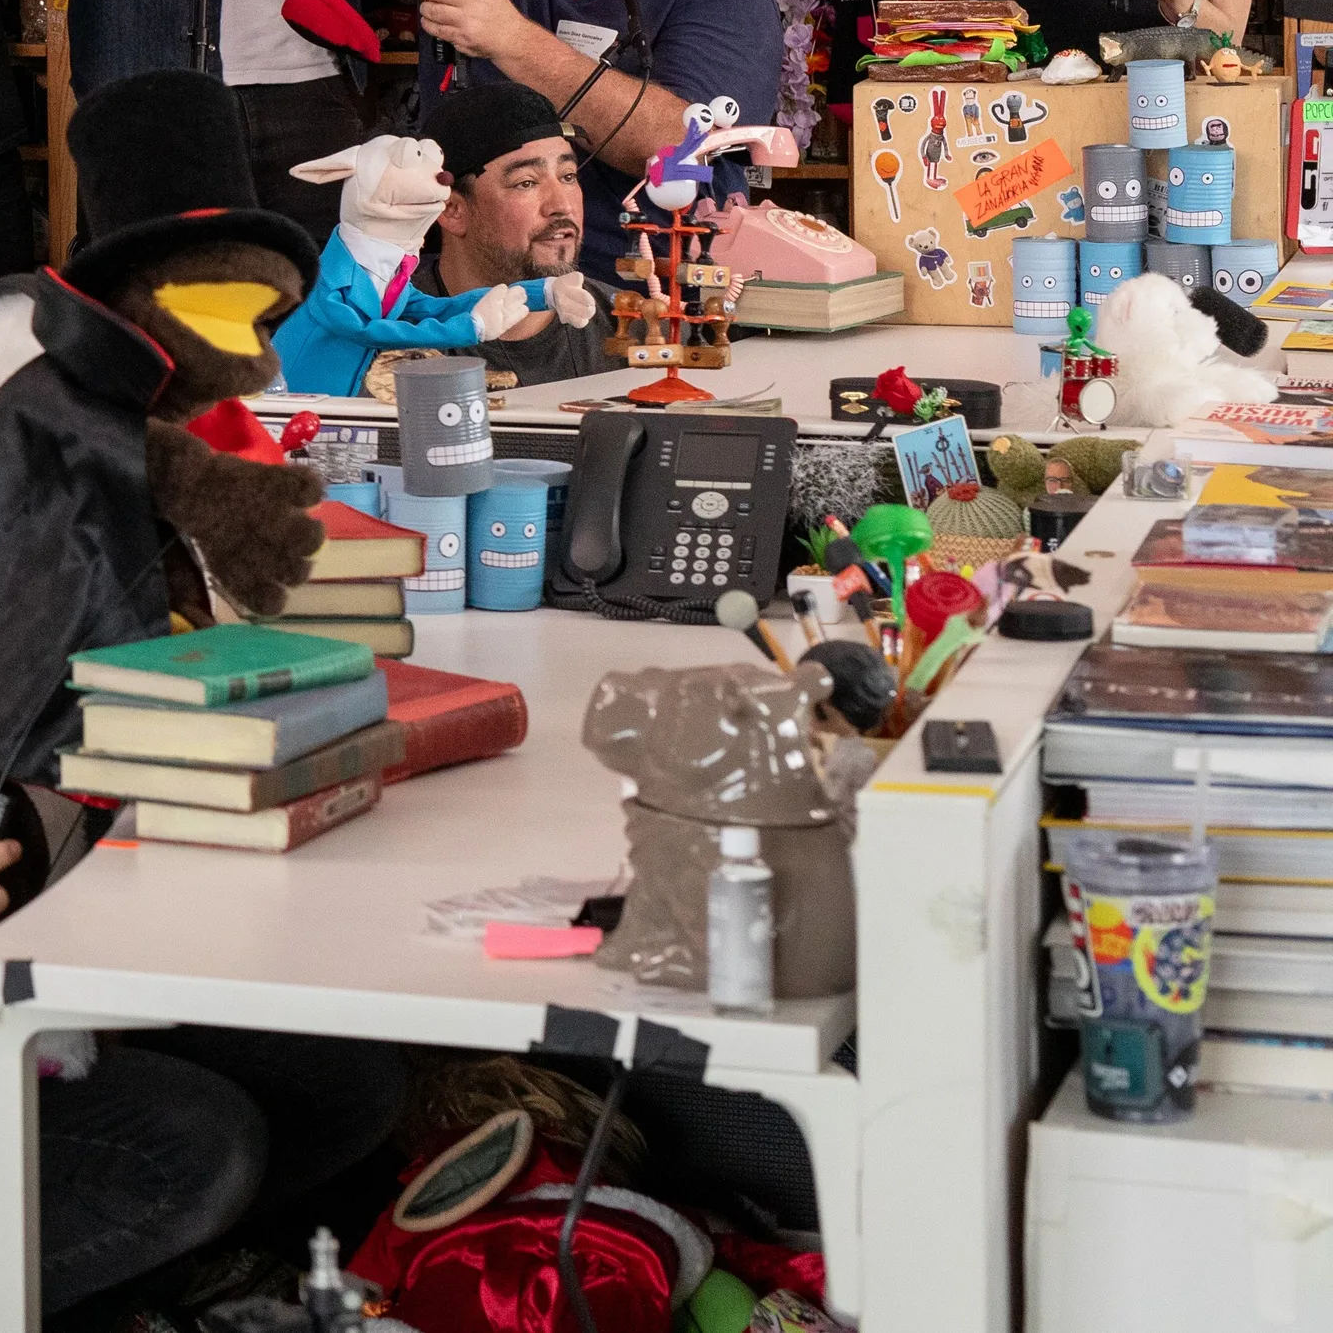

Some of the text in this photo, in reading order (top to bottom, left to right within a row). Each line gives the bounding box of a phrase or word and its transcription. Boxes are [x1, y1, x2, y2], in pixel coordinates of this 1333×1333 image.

[977, 180, 992, 197] LA
[992, 160, 1030, 187] GRAN
[1208, 412, 1314, 427] WOMEN
